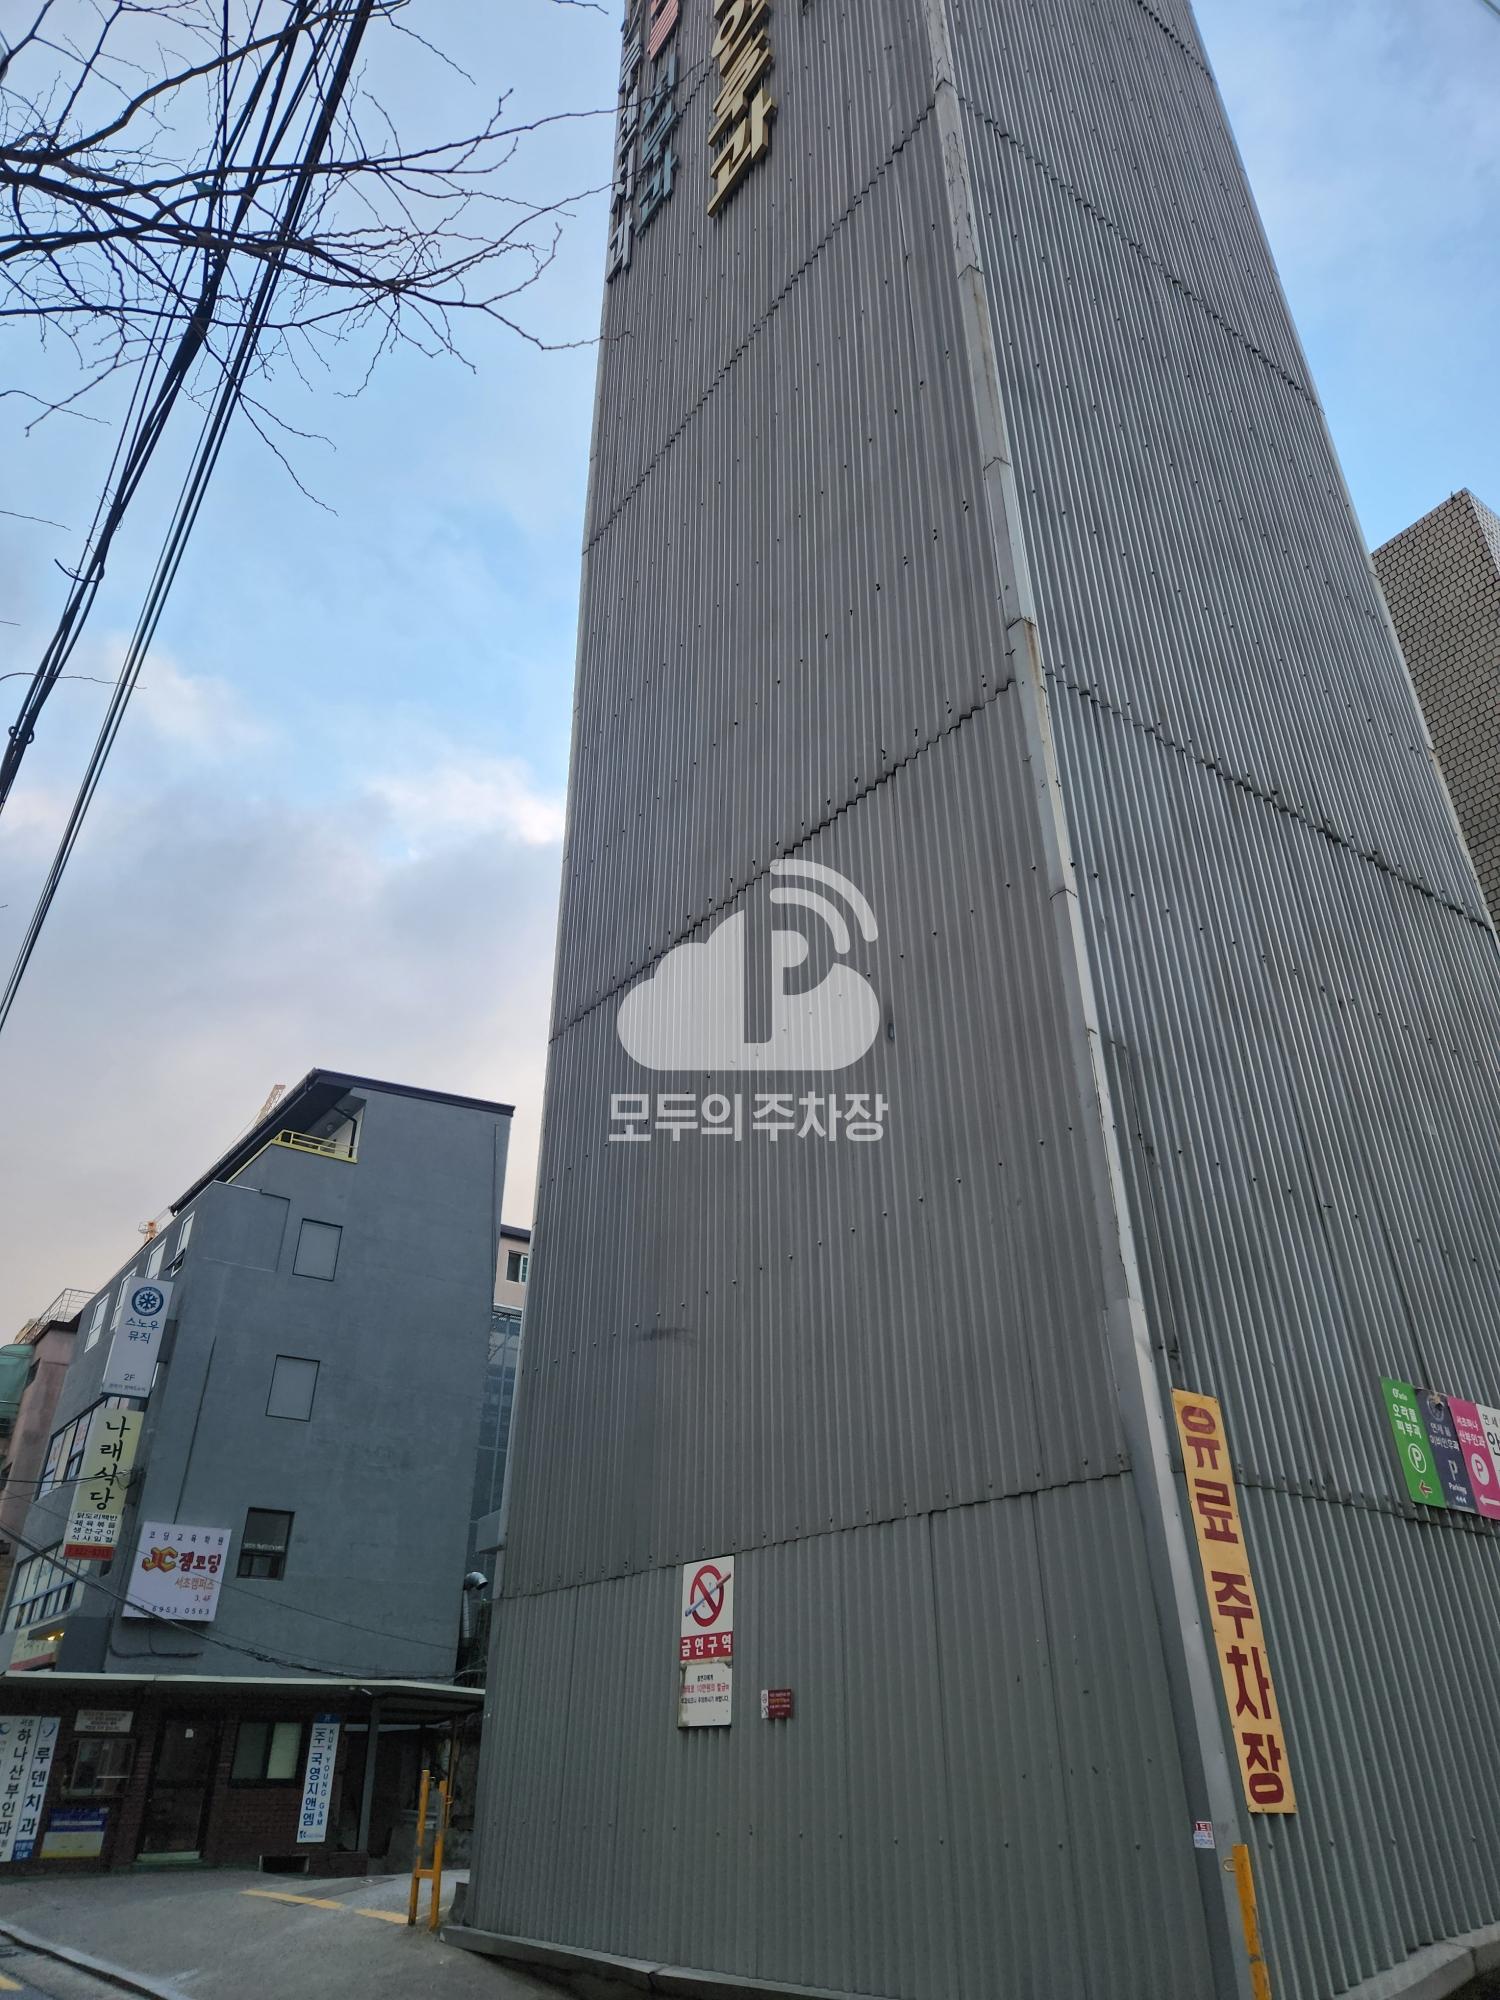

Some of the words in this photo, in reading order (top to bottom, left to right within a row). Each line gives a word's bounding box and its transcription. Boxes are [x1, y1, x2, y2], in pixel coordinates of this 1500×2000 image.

[125, 1317, 159, 1330] 스노우
[128, 1330, 151, 1344] 뮤직
[124, 1373, 135, 1381] 2F
[1392, 1404, 1418, 1423] 오라클
[1395, 1420, 1422, 1439] 피부과
[90, 1416, 131, 1511] 나래식당
[179, 1551, 222, 1574] 잼코딩
[175, 1576, 215, 1591] 서초캠퍼스
[1181, 1404, 1239, 1545] 유료
[1210, 1570, 1285, 1805] 주차장
[681, 1633, 732, 1657] 금연구역
[327, 1727, 335, 1751] KUK
[0, 1728, 33, 1837] 하나산부인과
[320, 1757, 330, 1797] YOUNG
[18, 1747, 50, 1836] 루덴치과
